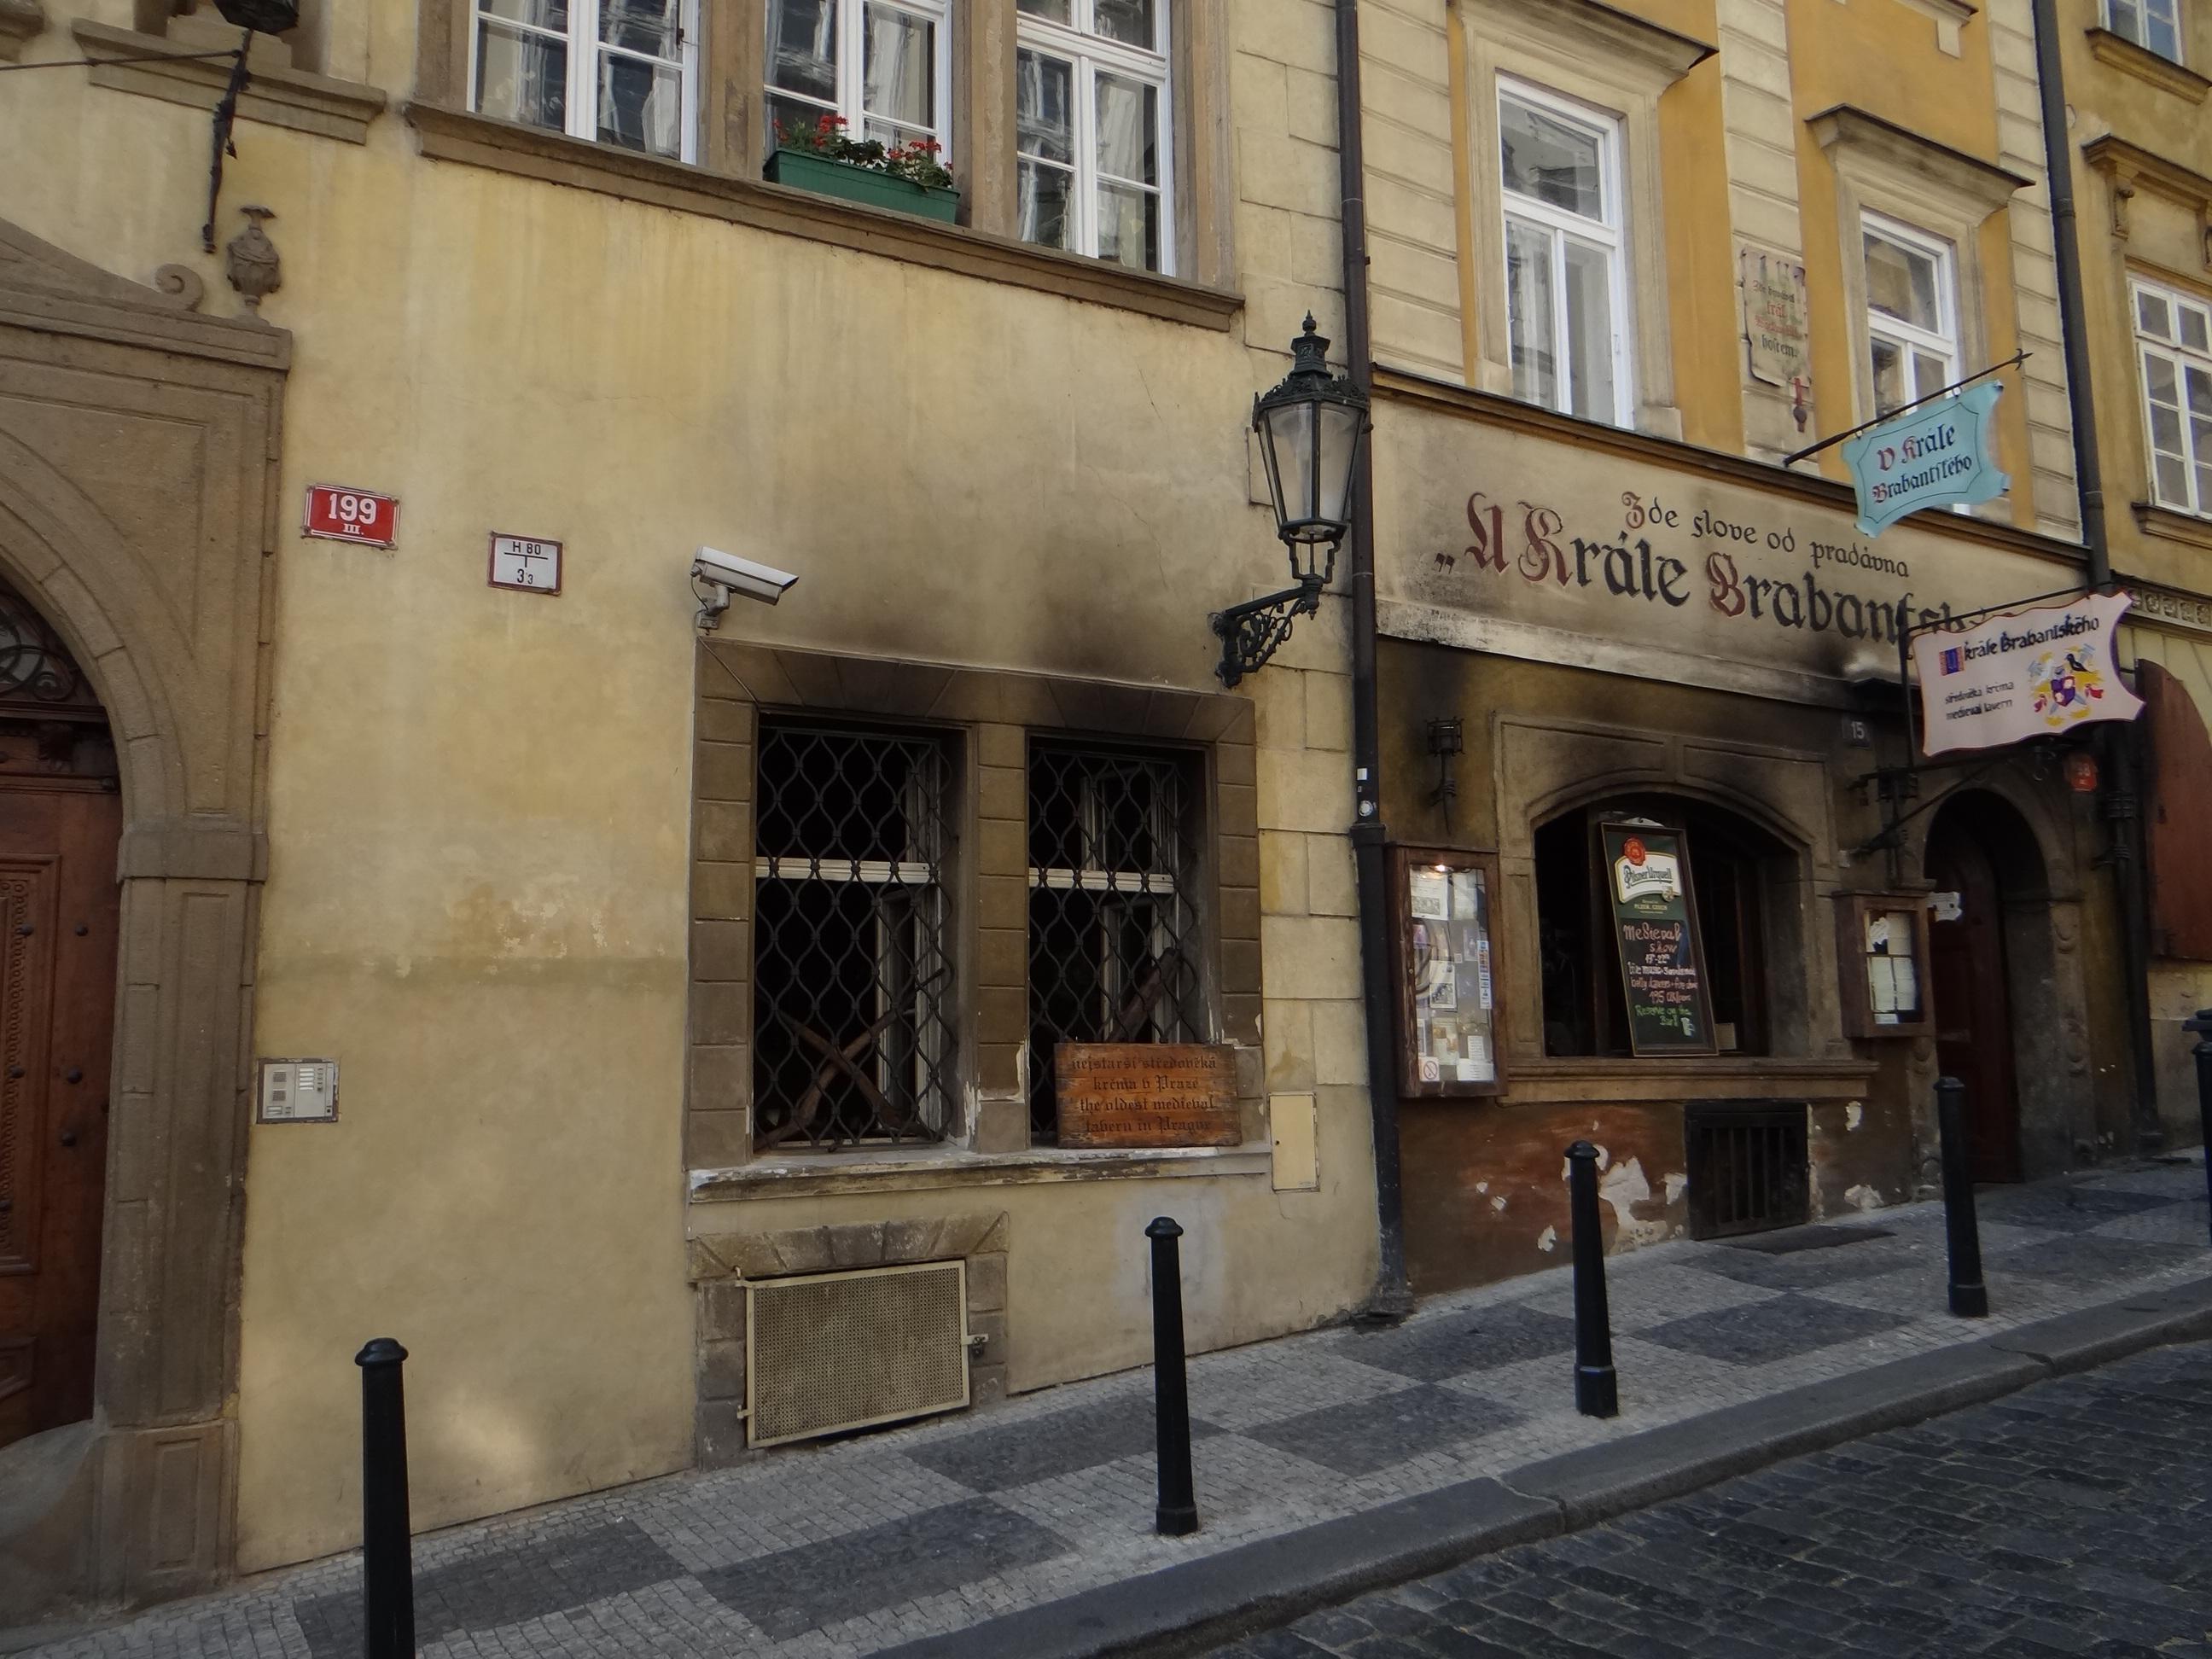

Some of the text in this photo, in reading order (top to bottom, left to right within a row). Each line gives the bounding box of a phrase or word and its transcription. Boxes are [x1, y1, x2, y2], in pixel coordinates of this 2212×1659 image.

[329, 493, 377, 525] 199
[512, 541, 542, 556] H 80
[1516, 499, 1691, 608] Krále
[1691, 509, 1758, 544] slove
[1767, 527, 1796, 553] od
[1809, 540, 1910, 579] pradávna
[1851, 721, 1866, 740] 15
[1623, 864, 1673, 889] Pilsner Urquell
[1080, 1093, 1215, 1113] the oldest medieval
[1138, 1118, 1153, 1132] in
